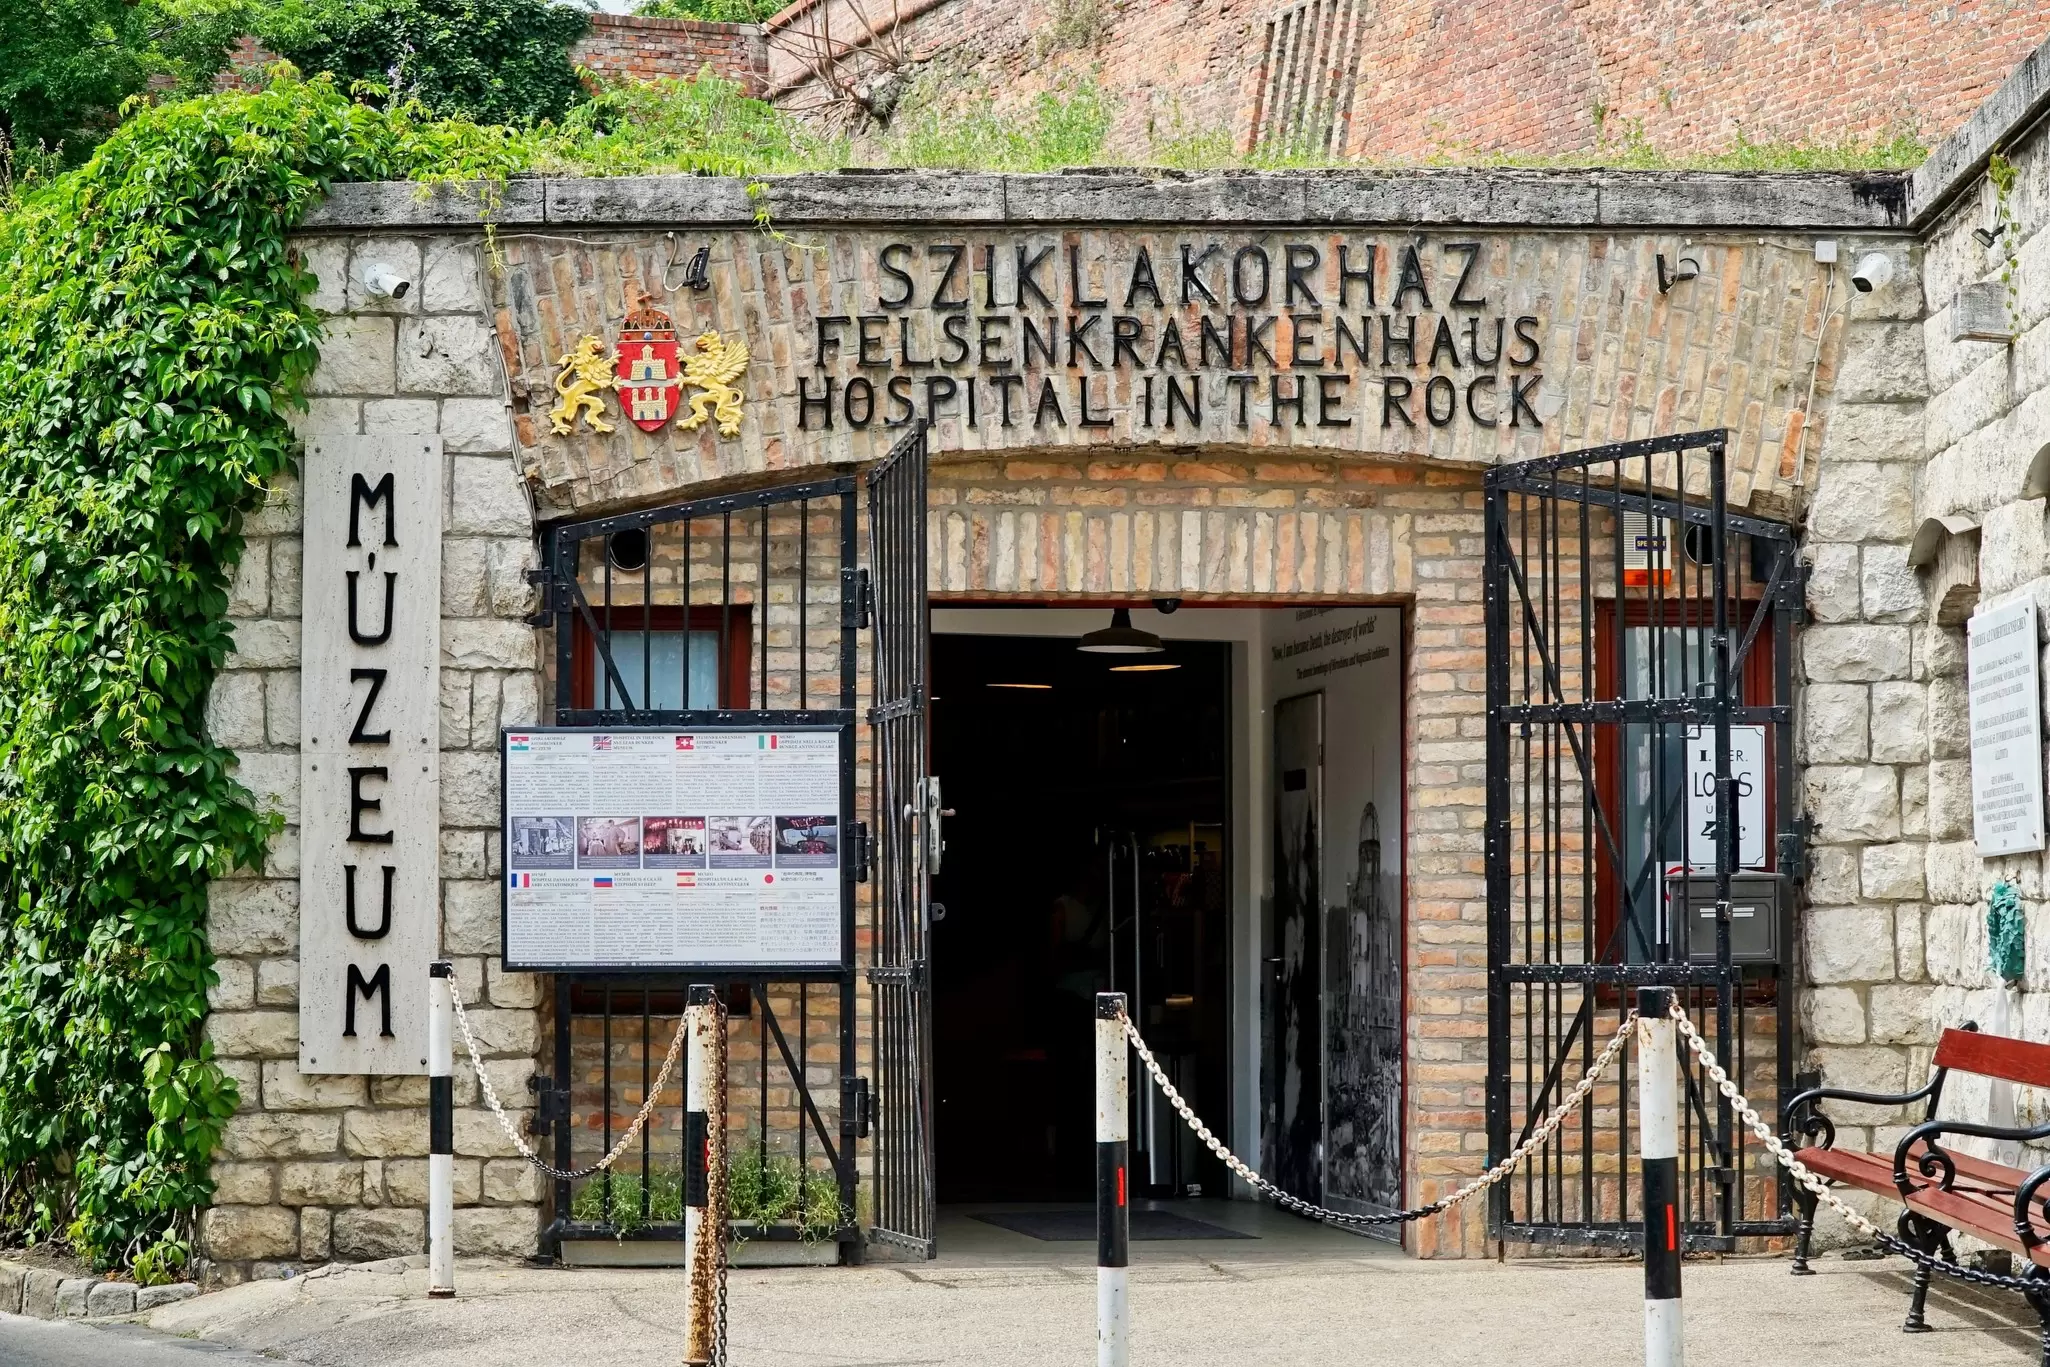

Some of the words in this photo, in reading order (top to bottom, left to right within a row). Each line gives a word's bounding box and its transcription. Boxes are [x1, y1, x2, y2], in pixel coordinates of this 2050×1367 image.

[879, 234, 1487, 308] SZIKLAKÓRHÁZ
[815, 314, 1540, 368] FELSENKRANKENHAUS
[798, 374, 1114, 429] HOSPITAL
[1142, 374, 1201, 427] IN
[1228, 375, 1352, 427] THE
[1382, 374, 1543, 428] ROCK
[343, 472, 399, 1038] MÚZEUM
[1695, 772, 1753, 797] LOS
